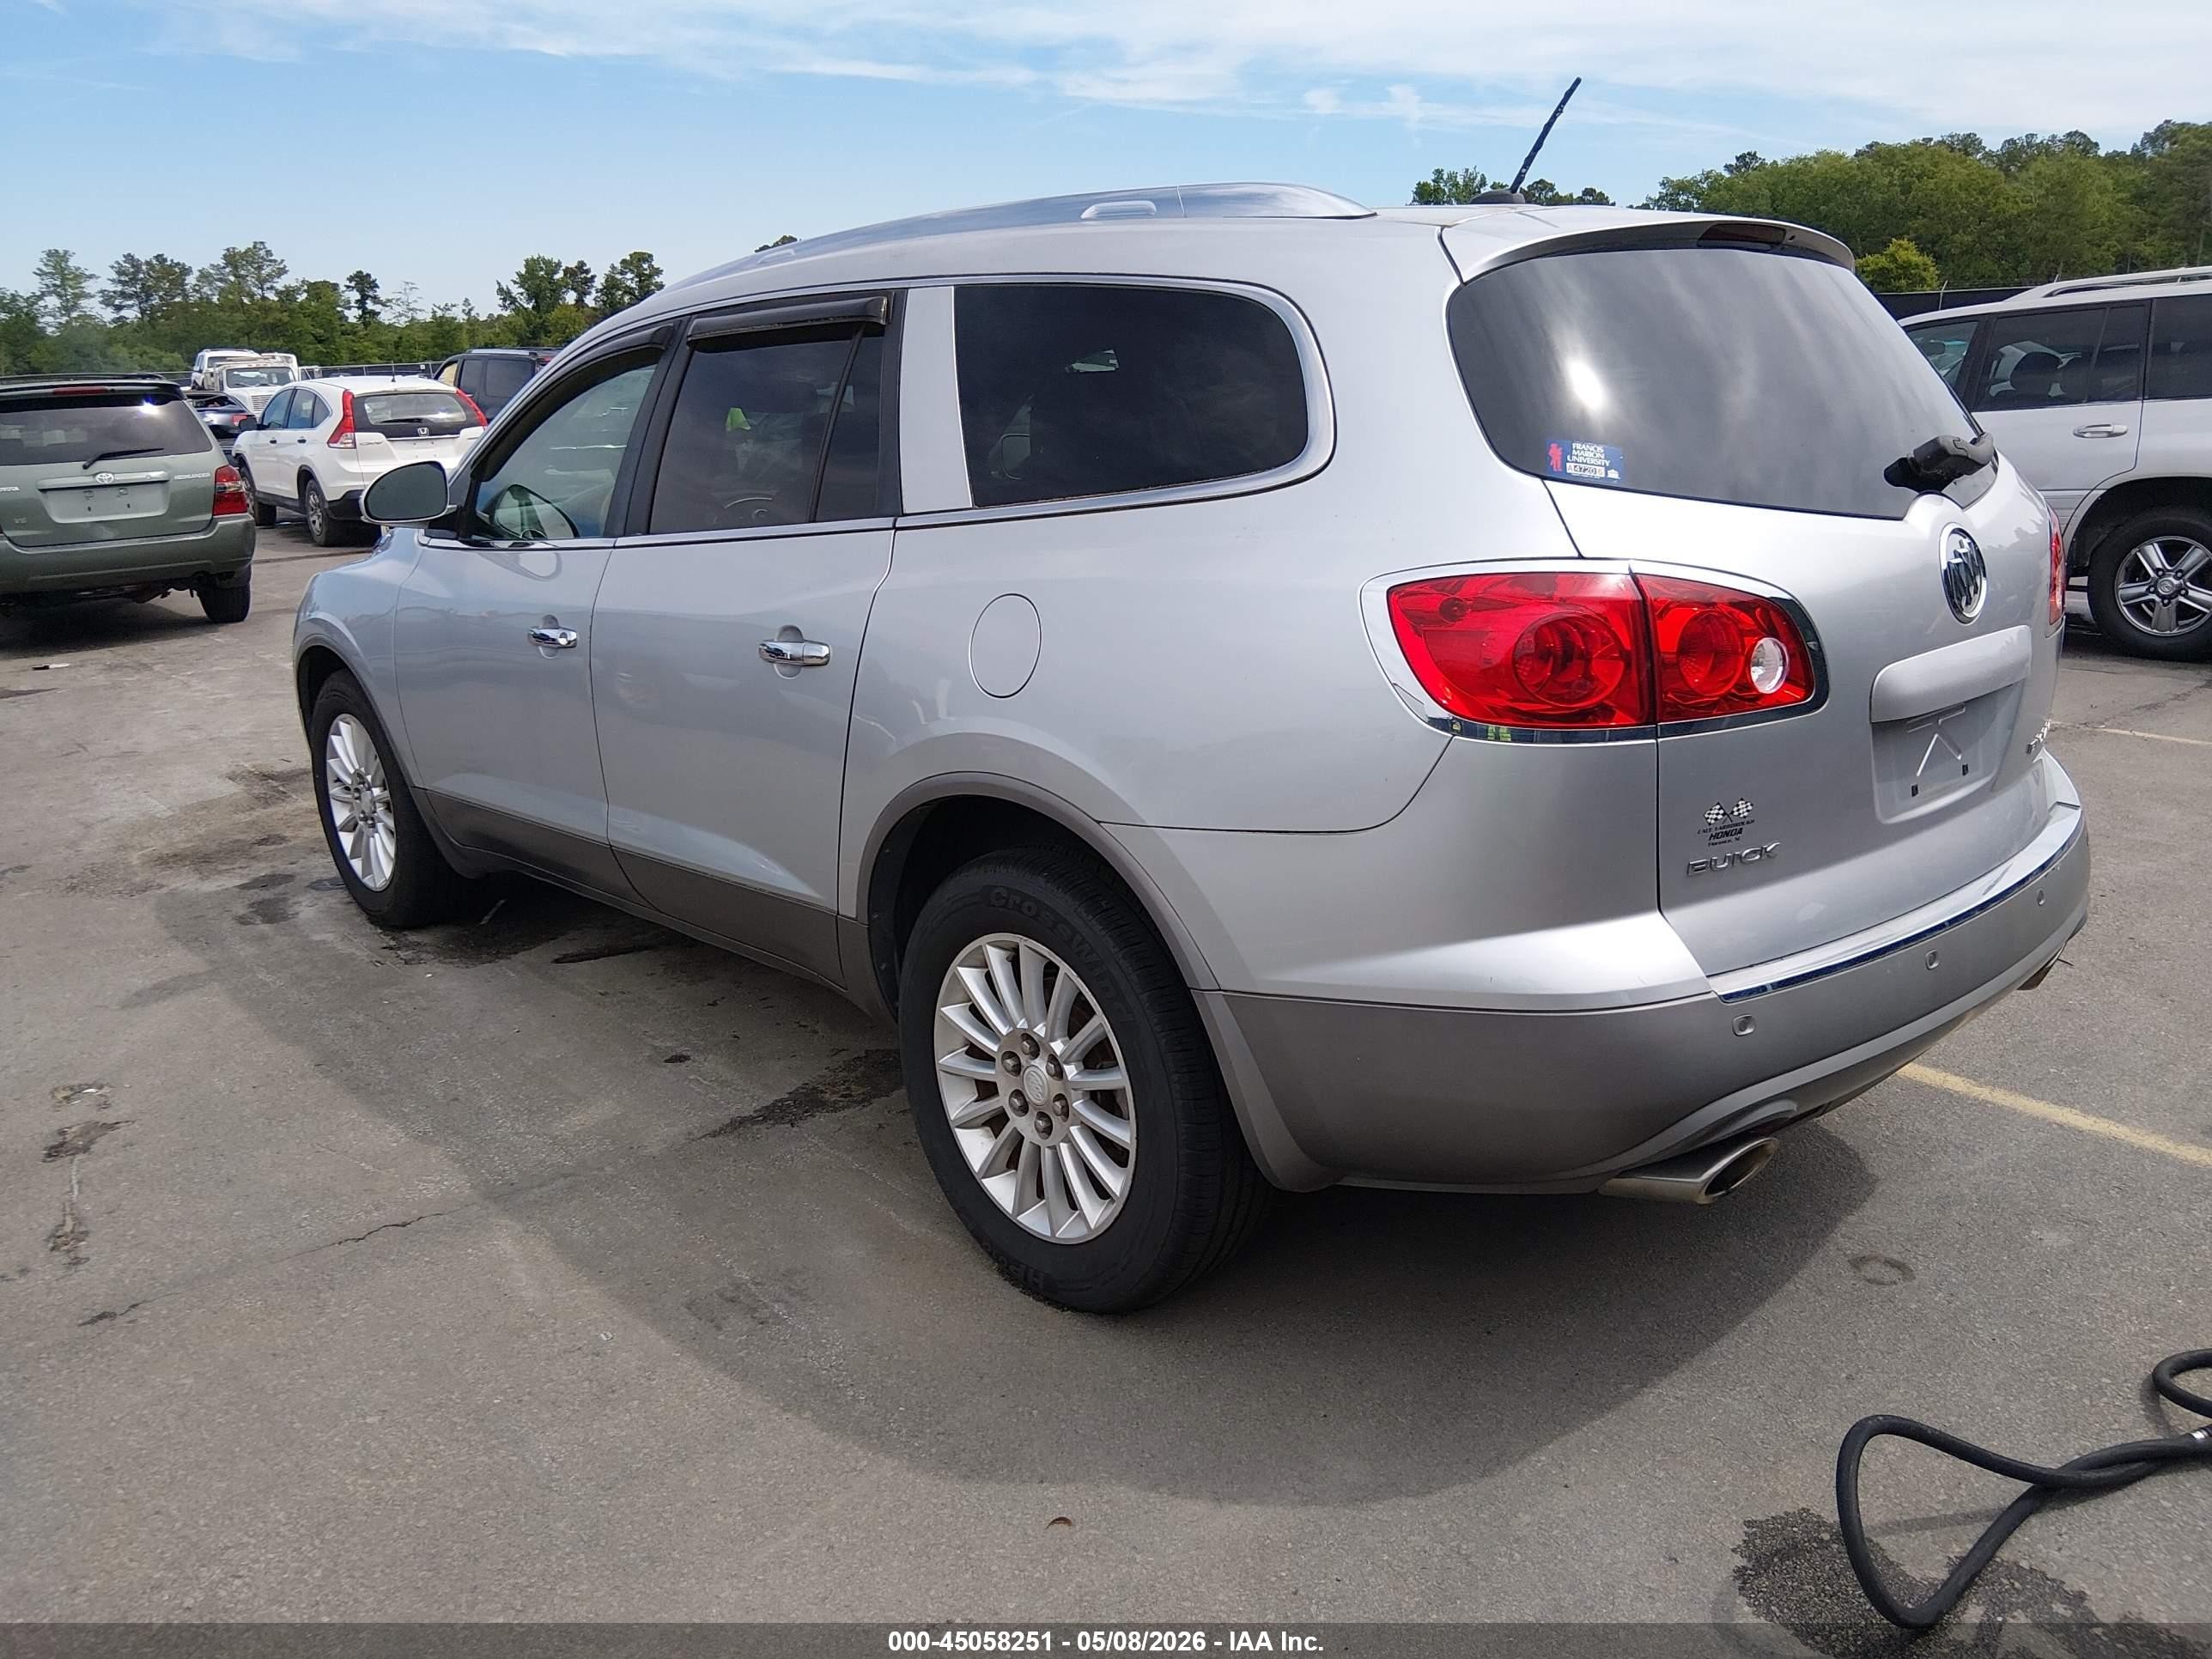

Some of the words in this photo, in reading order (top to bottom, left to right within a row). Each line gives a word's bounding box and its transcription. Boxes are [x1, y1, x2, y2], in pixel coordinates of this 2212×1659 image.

[1571, 442, 1604, 453] FRANCIS
[1571, 449, 1605, 459] MARION
[1566, 454, 1611, 467] UNIVERSITY
[1709, 827, 1743, 842] HONDA
[1686, 842, 1780, 877] BUICK
